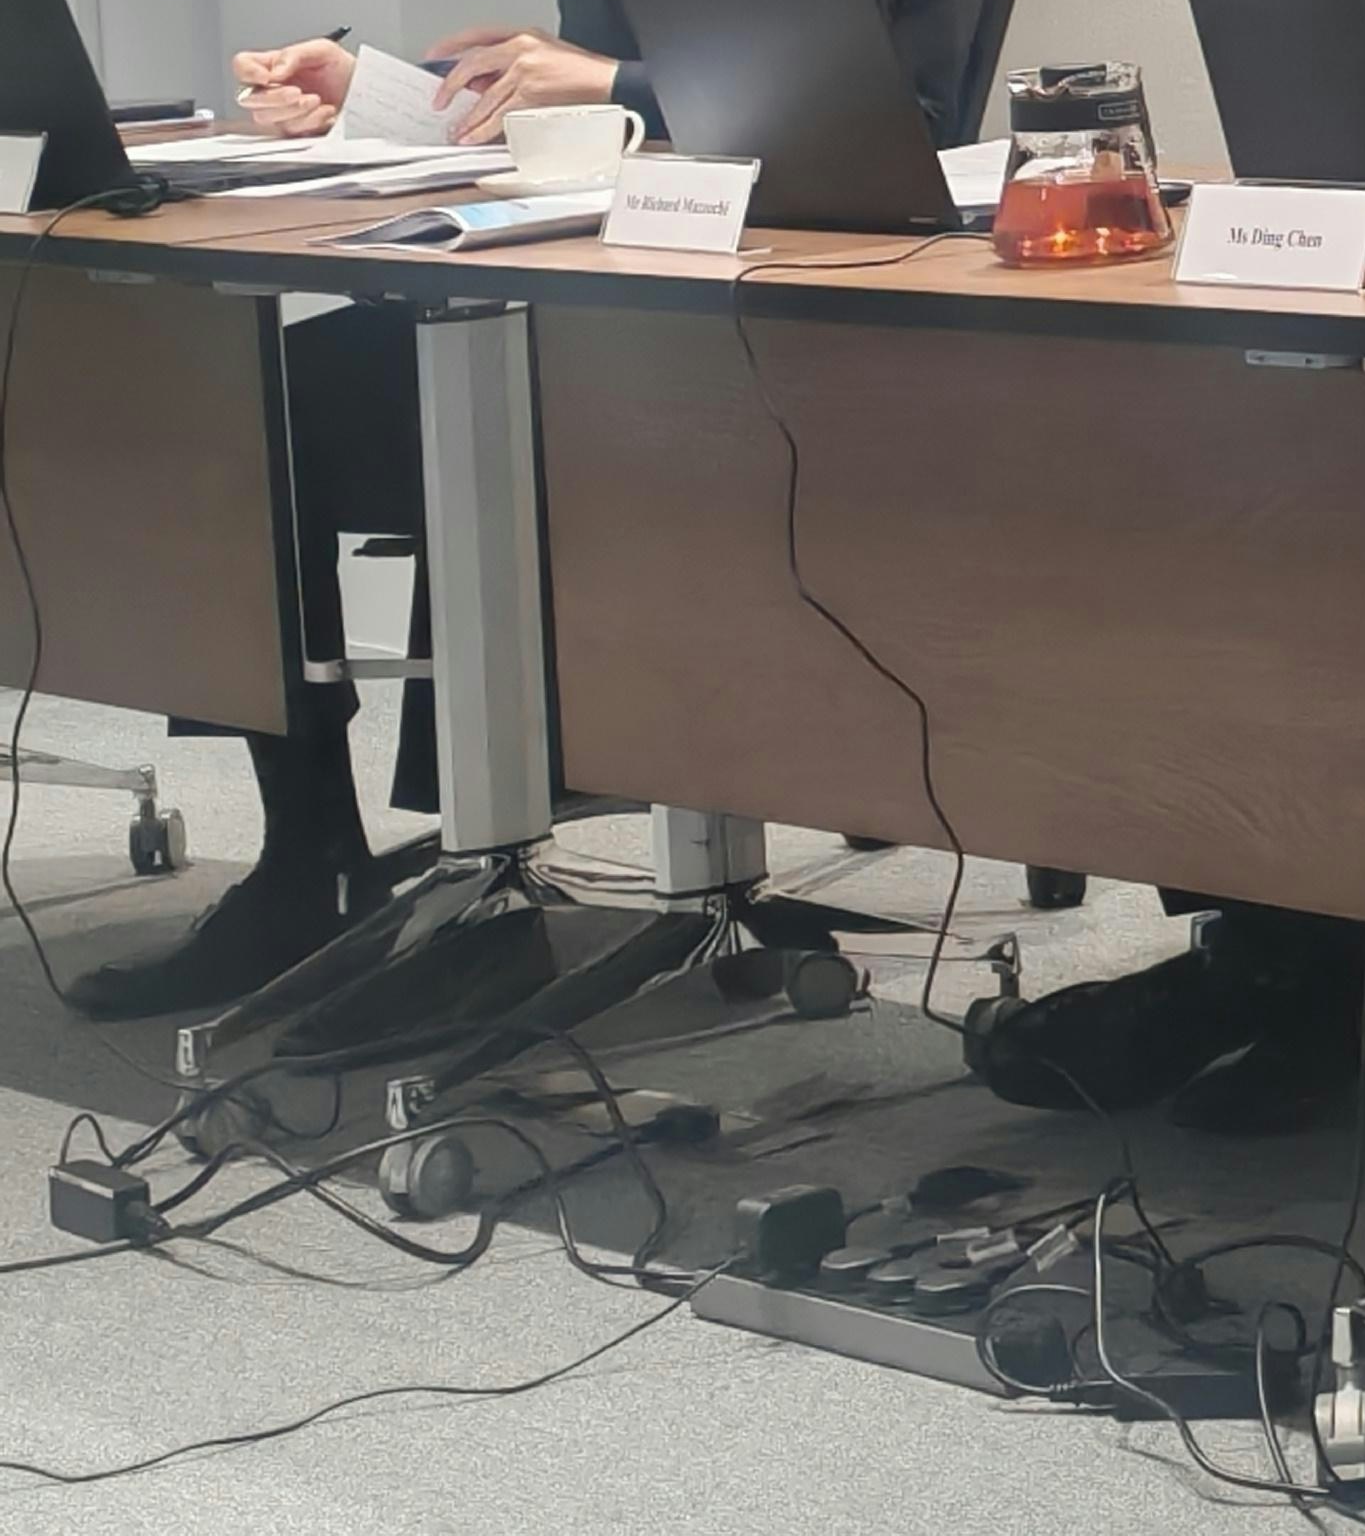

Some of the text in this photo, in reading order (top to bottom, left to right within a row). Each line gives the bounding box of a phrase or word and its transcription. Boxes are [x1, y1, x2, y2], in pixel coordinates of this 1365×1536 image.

[626, 194, 641, 210] Mr
[641, 195, 682, 213] Richard
[1227, 227, 1322, 248] Ms Ding Chen
